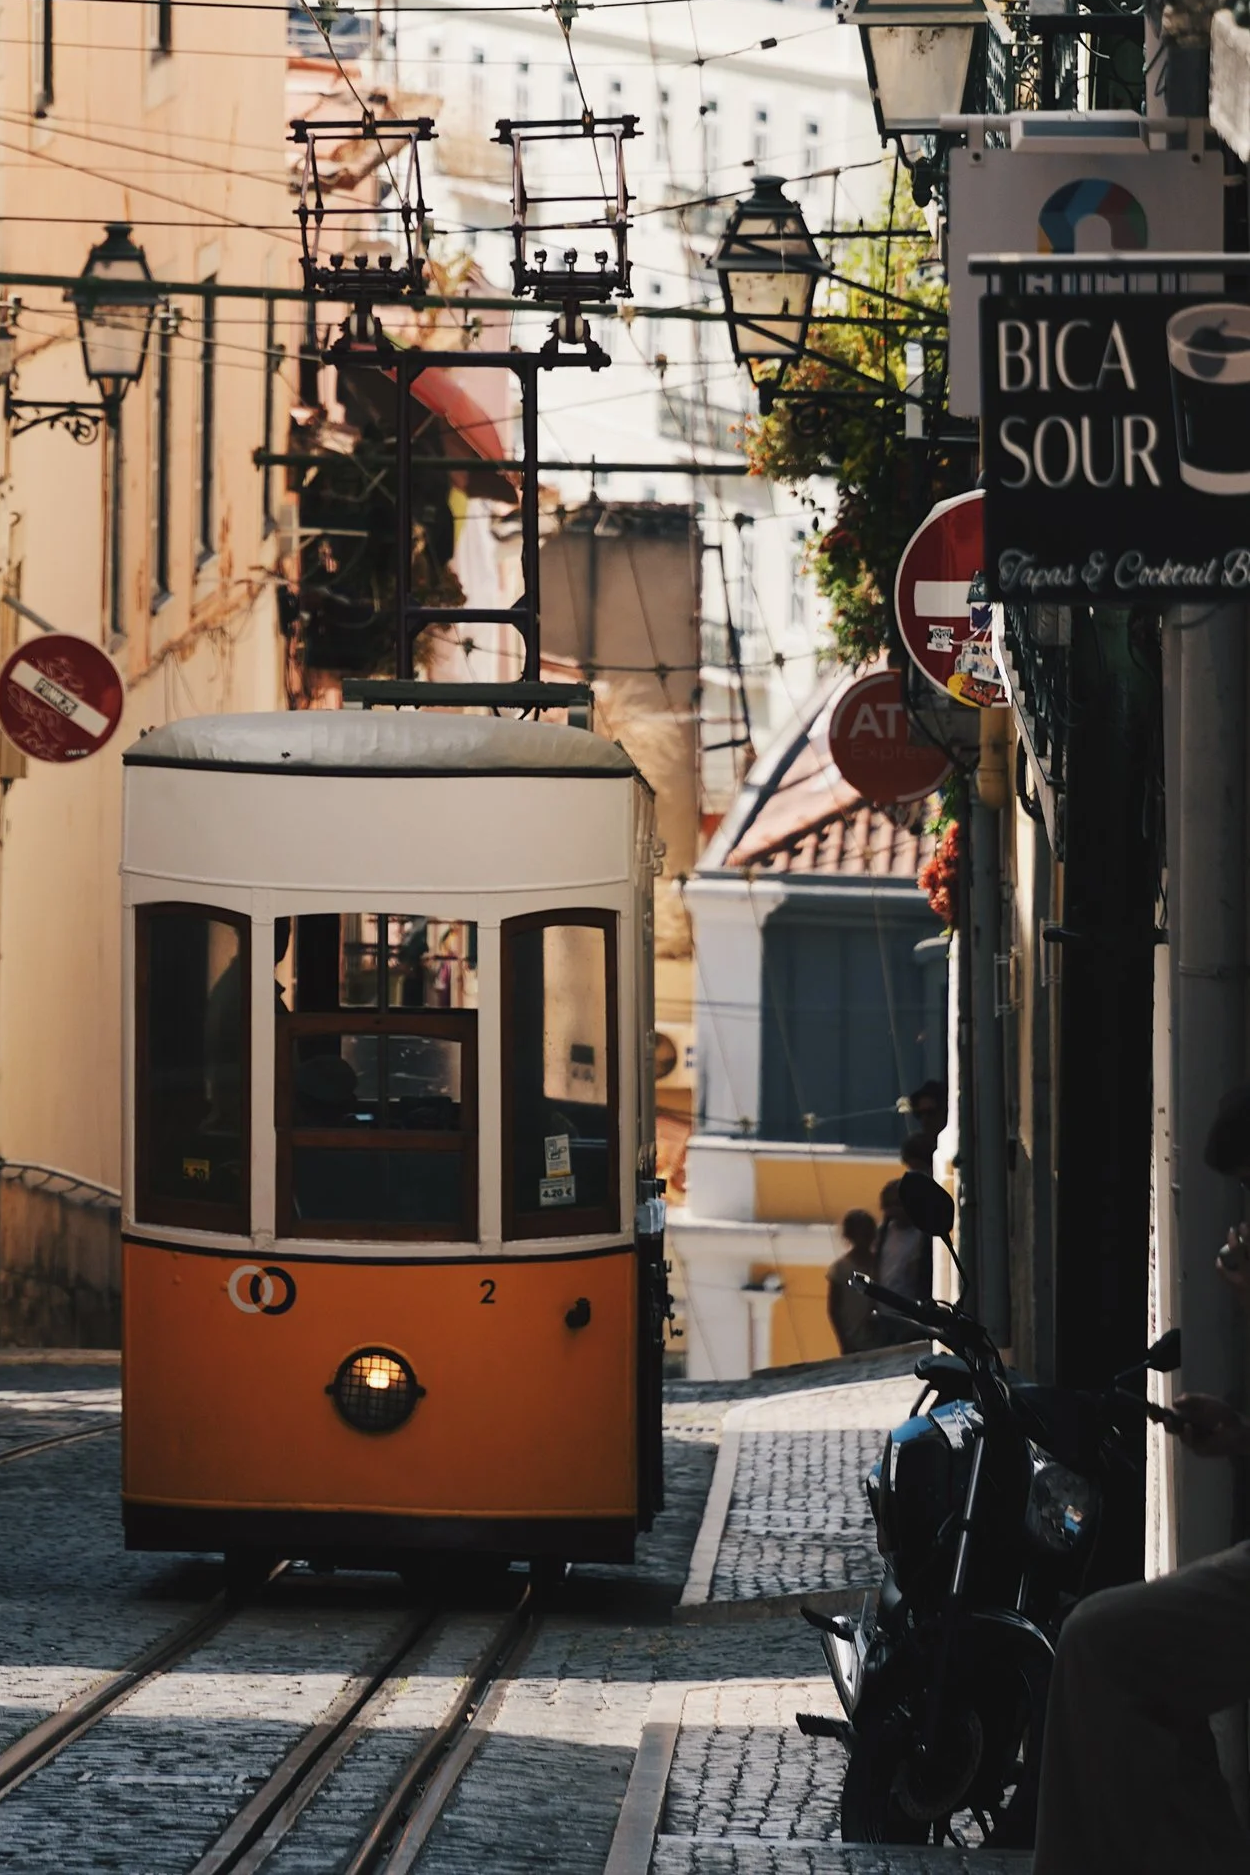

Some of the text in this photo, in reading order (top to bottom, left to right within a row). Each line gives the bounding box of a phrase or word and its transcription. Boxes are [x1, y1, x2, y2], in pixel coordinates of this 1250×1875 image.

[998, 319, 1137, 392] BICA
[999, 414, 1162, 489] SOUR
[998, 549, 1075, 595] Tapas
[1080, 550, 1107, 594] &
[1114, 550, 1218, 590] Cocktail
[848, 703, 911, 740] AT
[479, 1279, 496, 1304] 2
